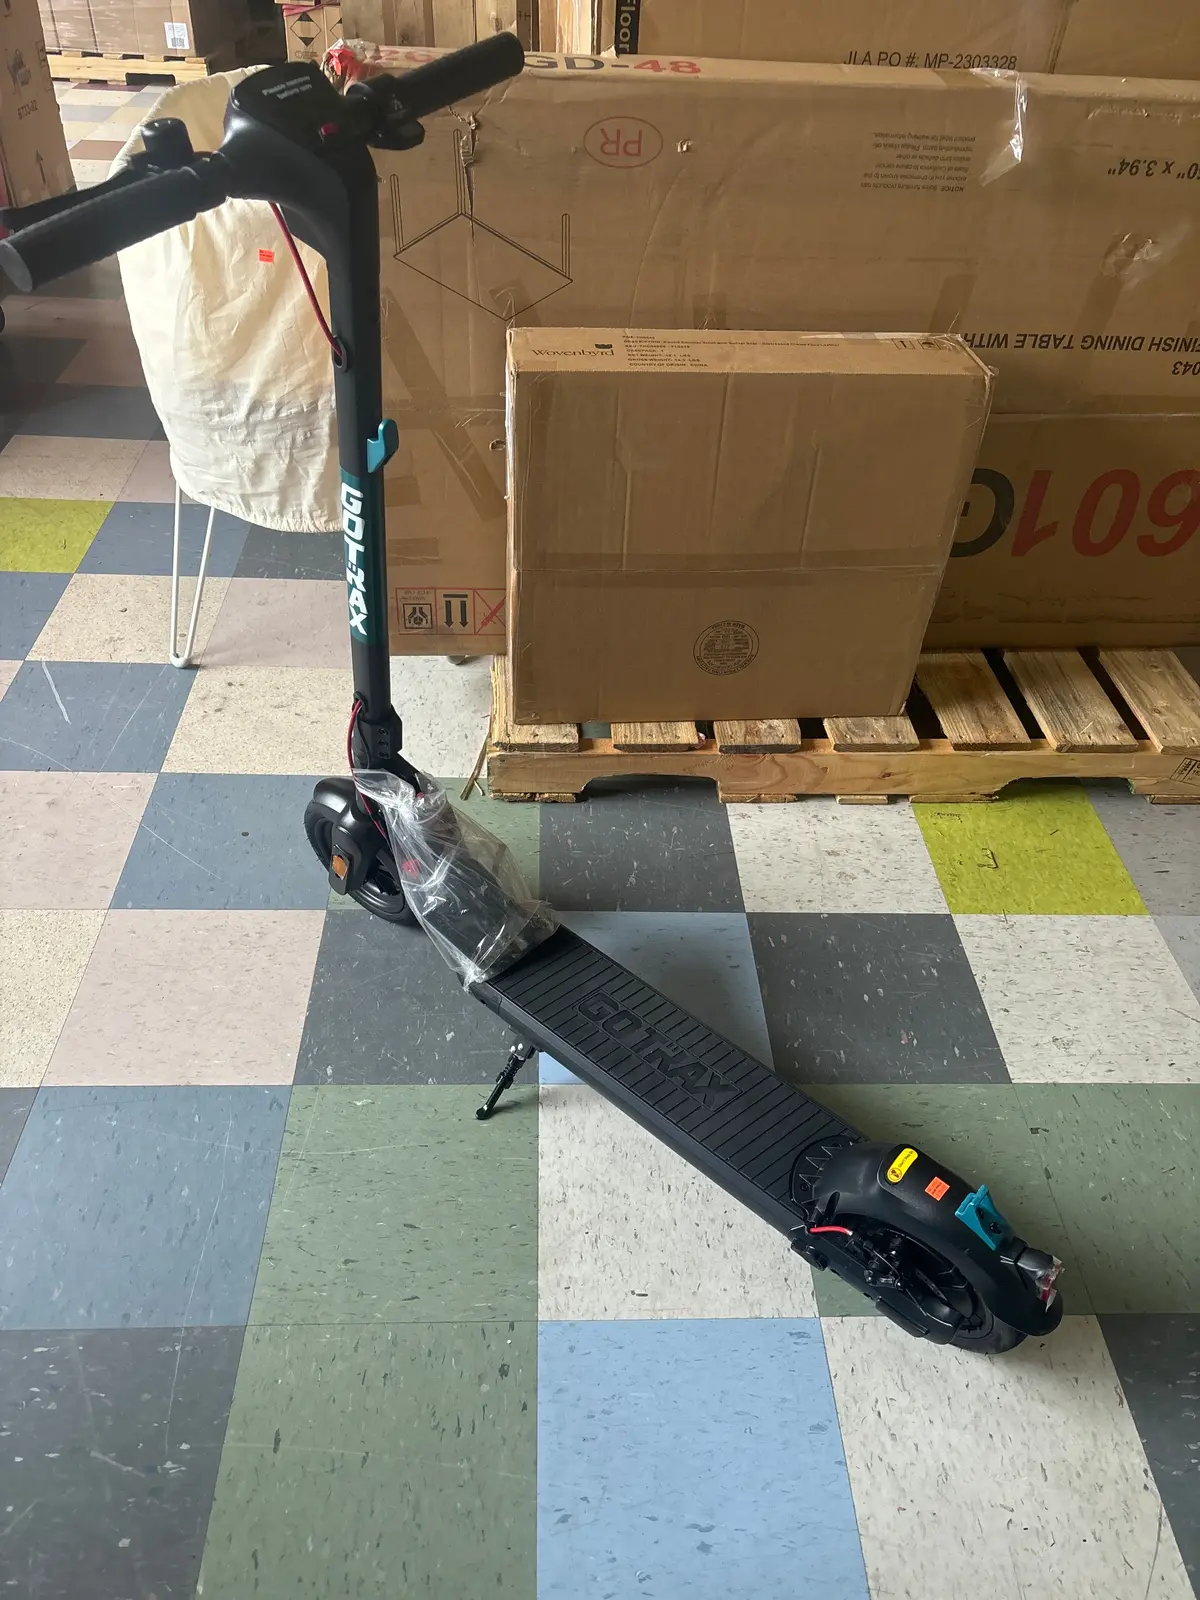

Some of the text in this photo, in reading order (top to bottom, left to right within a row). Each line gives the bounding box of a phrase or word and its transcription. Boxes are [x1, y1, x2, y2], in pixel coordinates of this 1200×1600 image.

[619, 0, 636, 52] loor
[877, 51, 901, 67] PO
[924, 53, 1018, 70] MP-2303328
[600, 128, 642, 157] PR
[1107, 158, 1157, 177] 3.94"
[1161, 161, 1175, 174] x
[964, 332, 1008, 349] WITH
[1014, 333, 1074, 350] TABLE
[1081, 334, 1145, 351] DINING
[341, 482, 368, 636] GOTRAX
[577, 992, 737, 1105] GOTRAX
